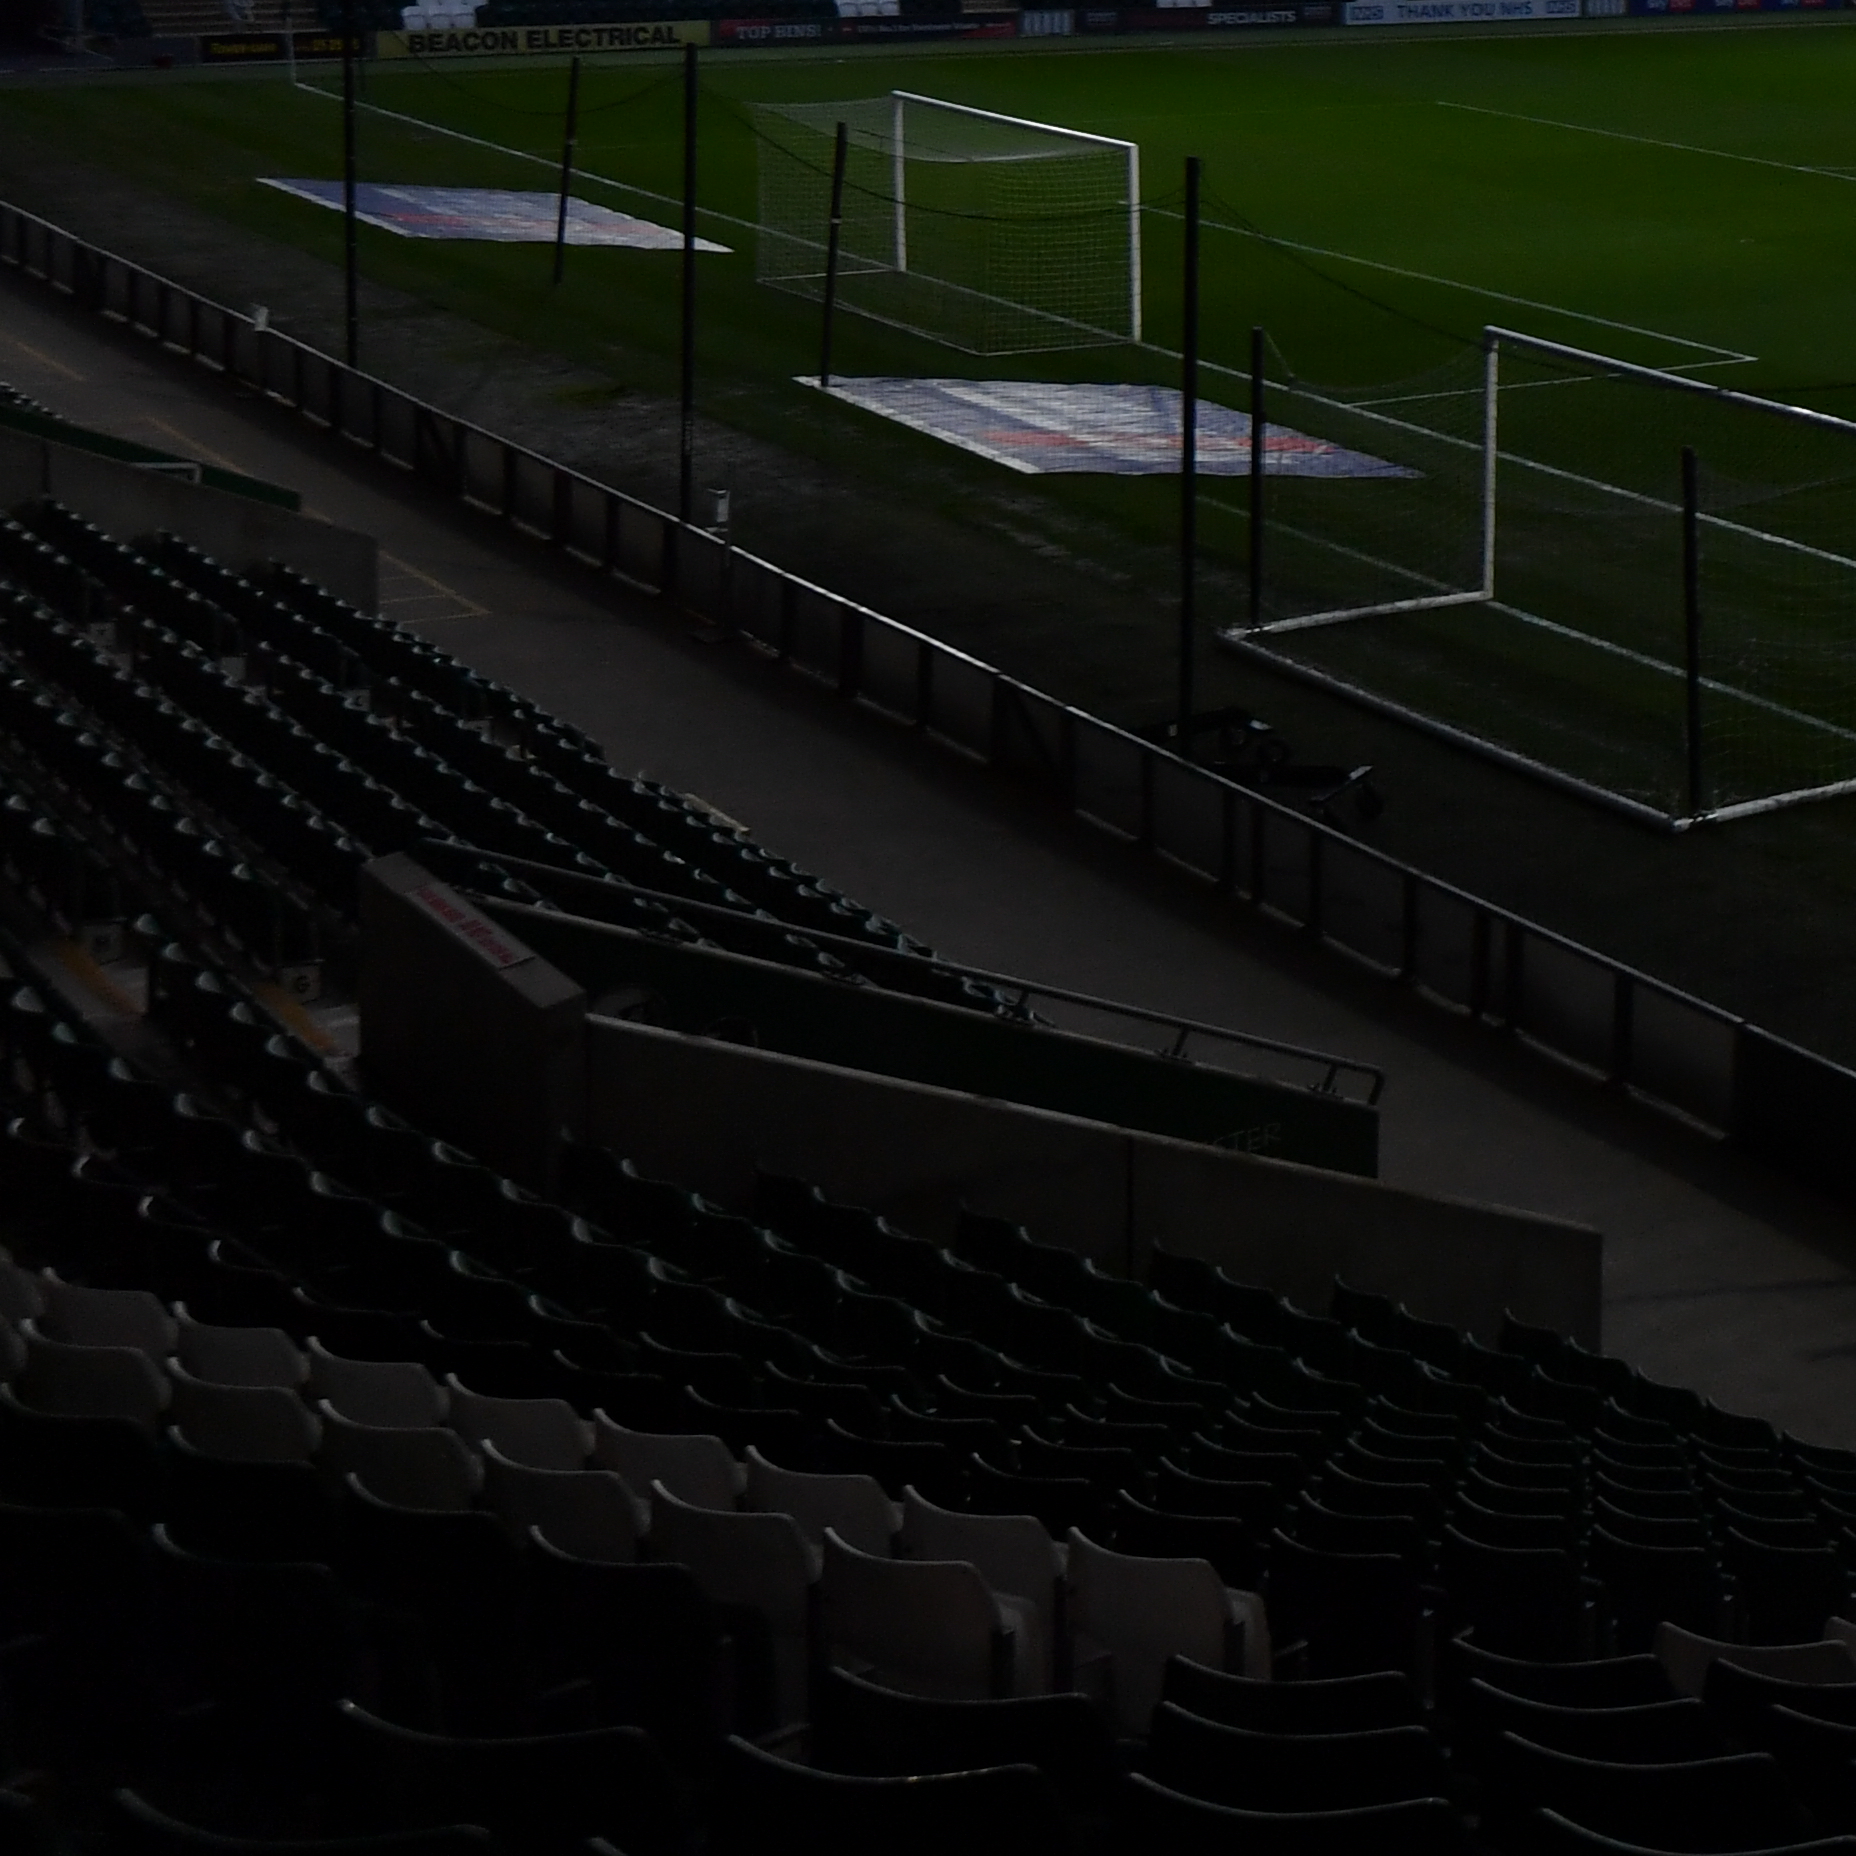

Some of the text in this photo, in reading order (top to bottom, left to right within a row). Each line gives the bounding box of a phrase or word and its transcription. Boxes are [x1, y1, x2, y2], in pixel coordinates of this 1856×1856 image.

[1206, 10, 1298, 26] SPECIALISTS
[1398, 4, 1455, 19] THANK
[1461, 2, 1497, 17] YOU
[1500, 0, 1533, 15] NHS
[406, 24, 682, 53] BEACON ELECTRICAL
[735, 25, 772, 40] TOP
